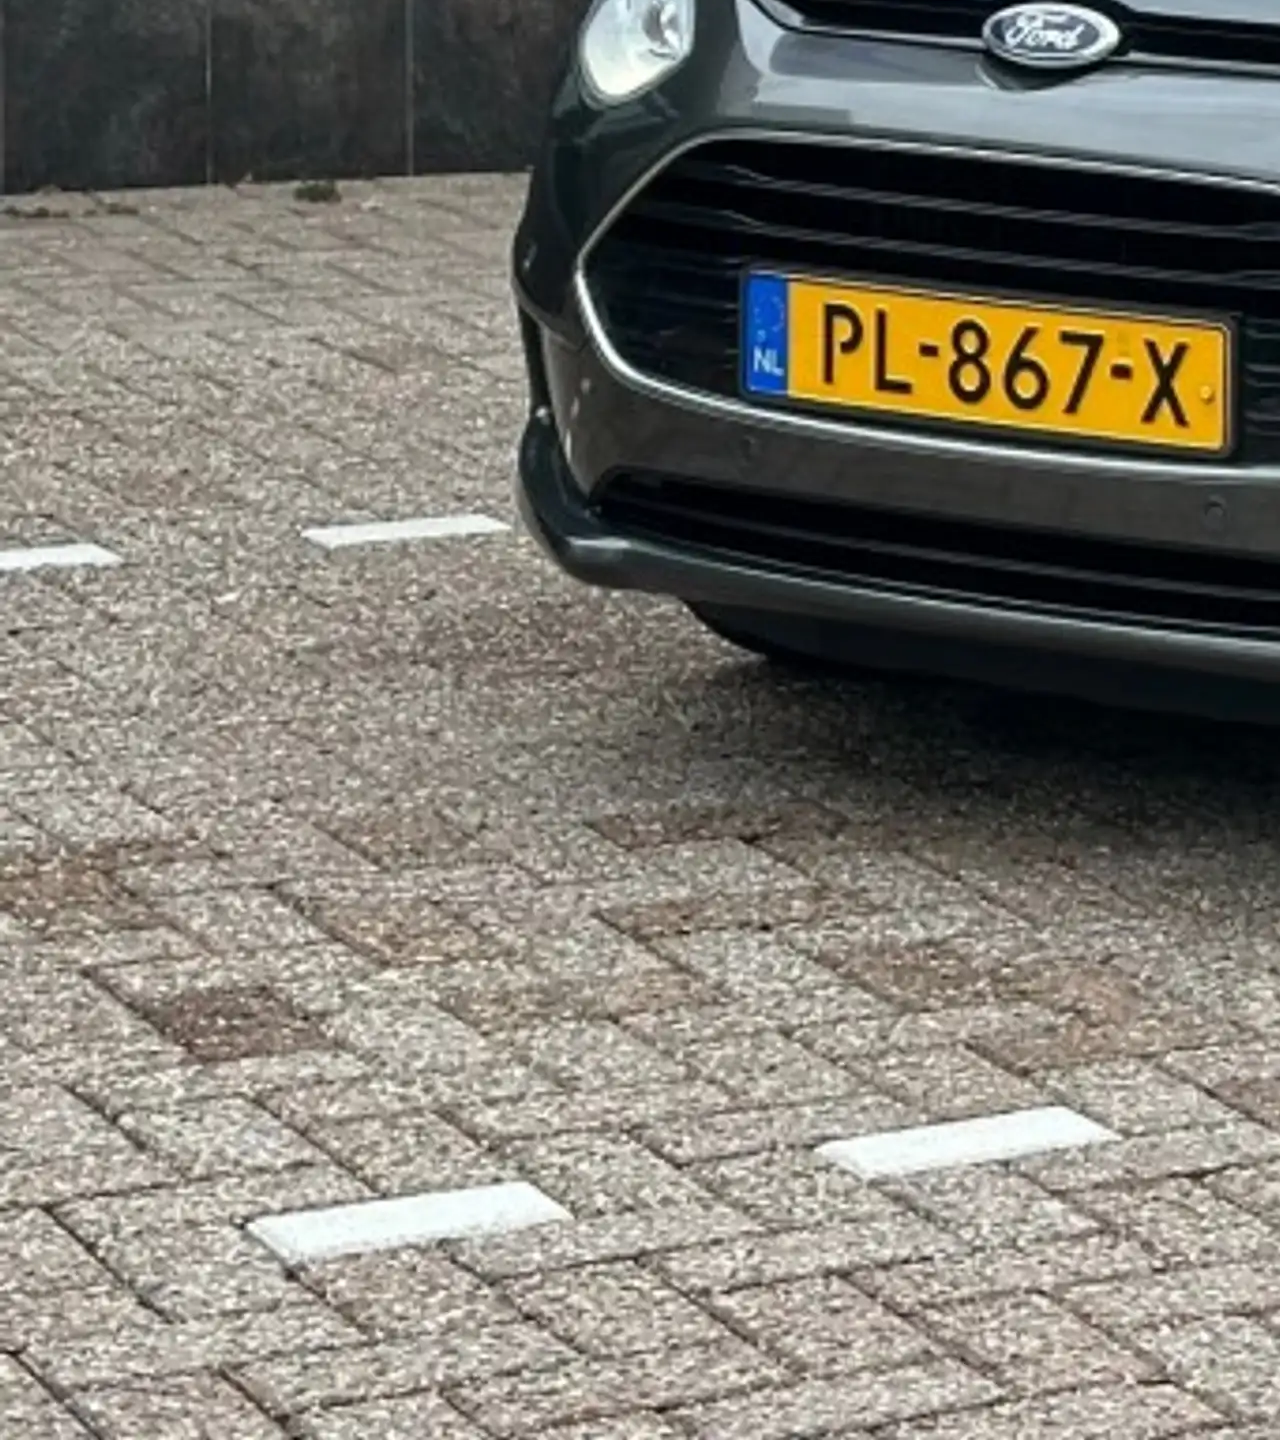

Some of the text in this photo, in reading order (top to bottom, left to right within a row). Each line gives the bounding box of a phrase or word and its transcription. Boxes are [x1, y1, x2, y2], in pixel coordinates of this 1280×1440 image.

[1005, 11, 1086, 51] Ford
[753, 345, 785, 377] NL
[822, 302, 1191, 428] PL-867-X
